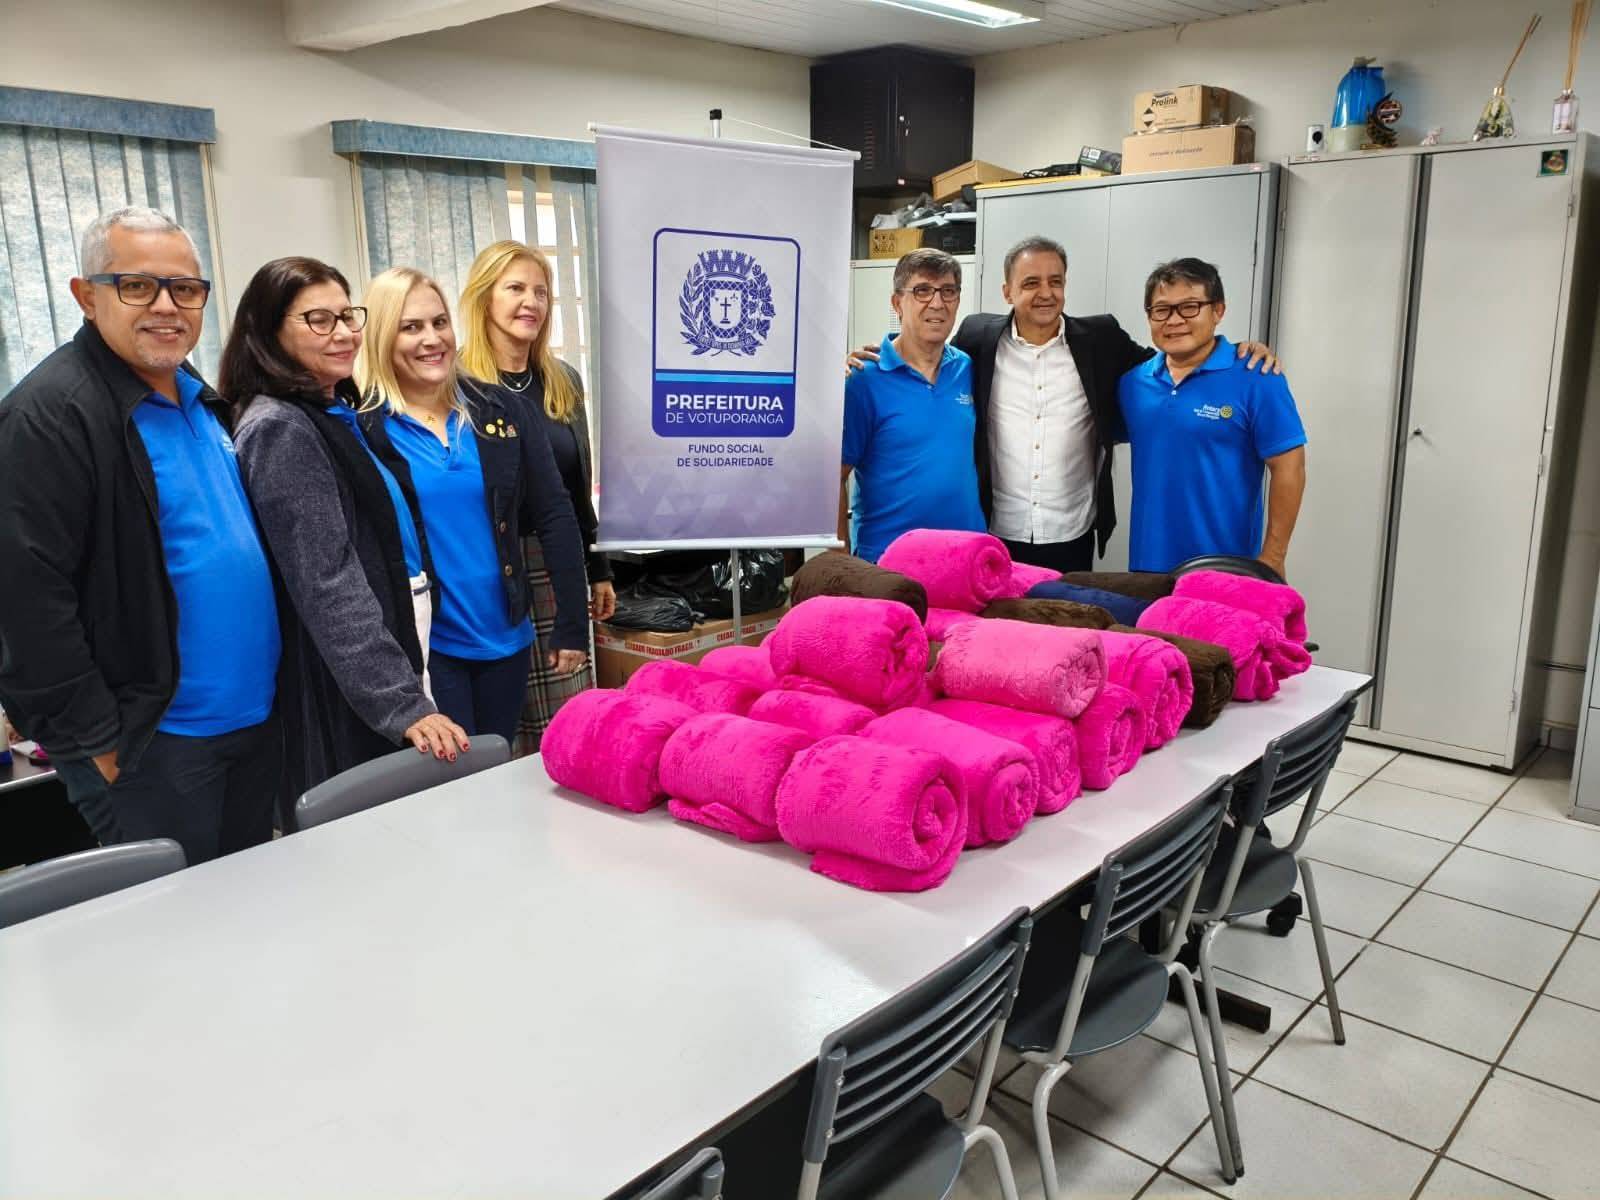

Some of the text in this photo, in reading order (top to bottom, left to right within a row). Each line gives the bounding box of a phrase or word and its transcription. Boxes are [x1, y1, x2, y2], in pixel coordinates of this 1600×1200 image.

[1151, 96, 1178, 107] Prolink
[665, 394, 784, 411] PREFEITURA
[665, 412, 784, 424] DE VOTUPORANGA
[688, 444, 764, 454] FUNDO SOCIAL
[677, 457, 774, 467] DE SOLIDARIEDADE
